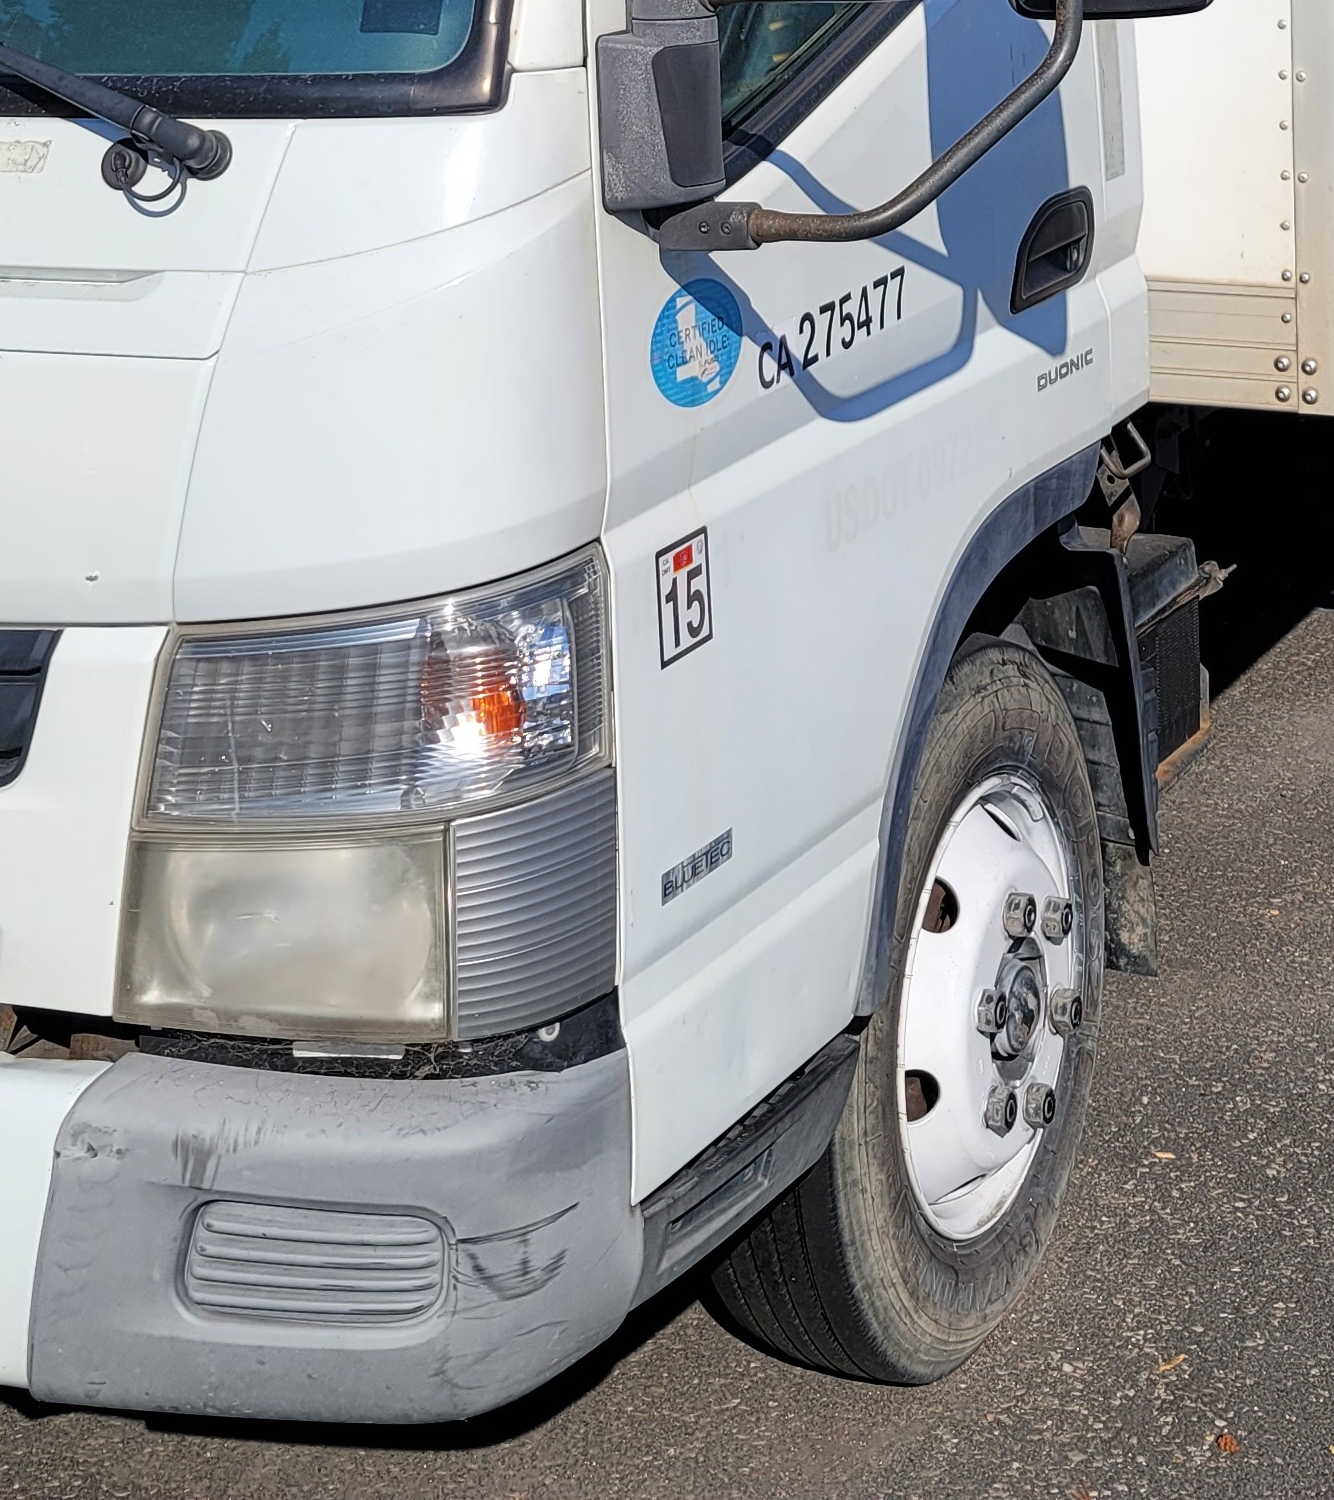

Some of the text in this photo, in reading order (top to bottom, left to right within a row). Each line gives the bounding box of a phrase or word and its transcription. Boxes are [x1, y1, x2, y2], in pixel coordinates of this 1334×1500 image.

[669, 316, 725, 347] CERTIFIED
[758, 265, 905, 389] CA 275477
[668, 344, 703, 370] CLEAN
[1037, 348, 1094, 392] DUONIC
[665, 563, 706, 649] 15
[664, 835, 731, 898] BLUETEC
